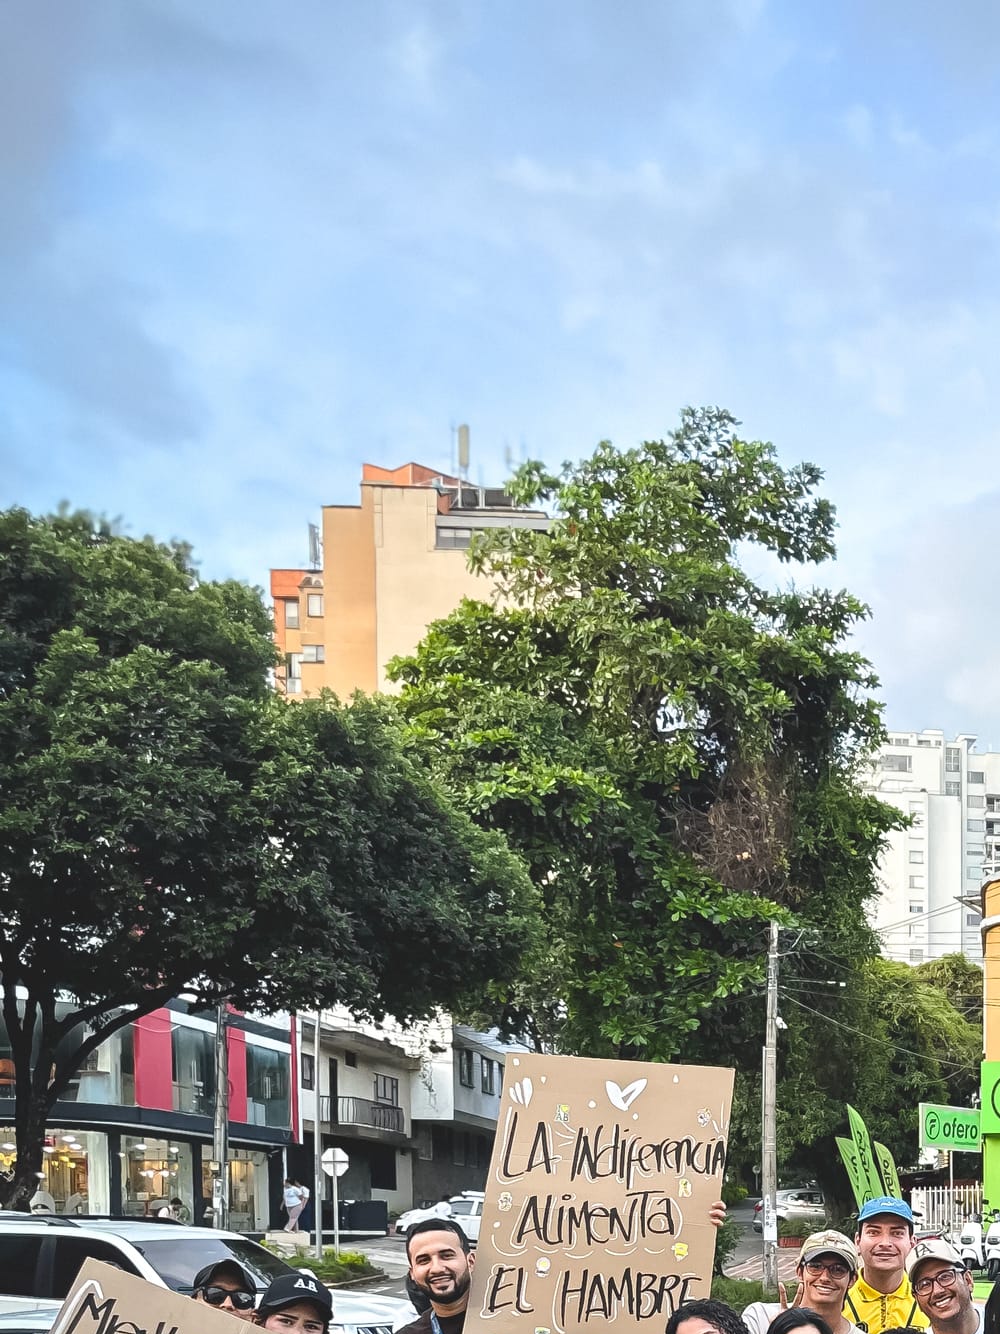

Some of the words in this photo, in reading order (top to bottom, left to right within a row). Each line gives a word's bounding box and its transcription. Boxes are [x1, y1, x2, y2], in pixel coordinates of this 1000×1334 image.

[503, 1112, 561, 1177] LA
[943, 1117, 978, 1141] ofero
[489, 1267, 534, 1315] EL
